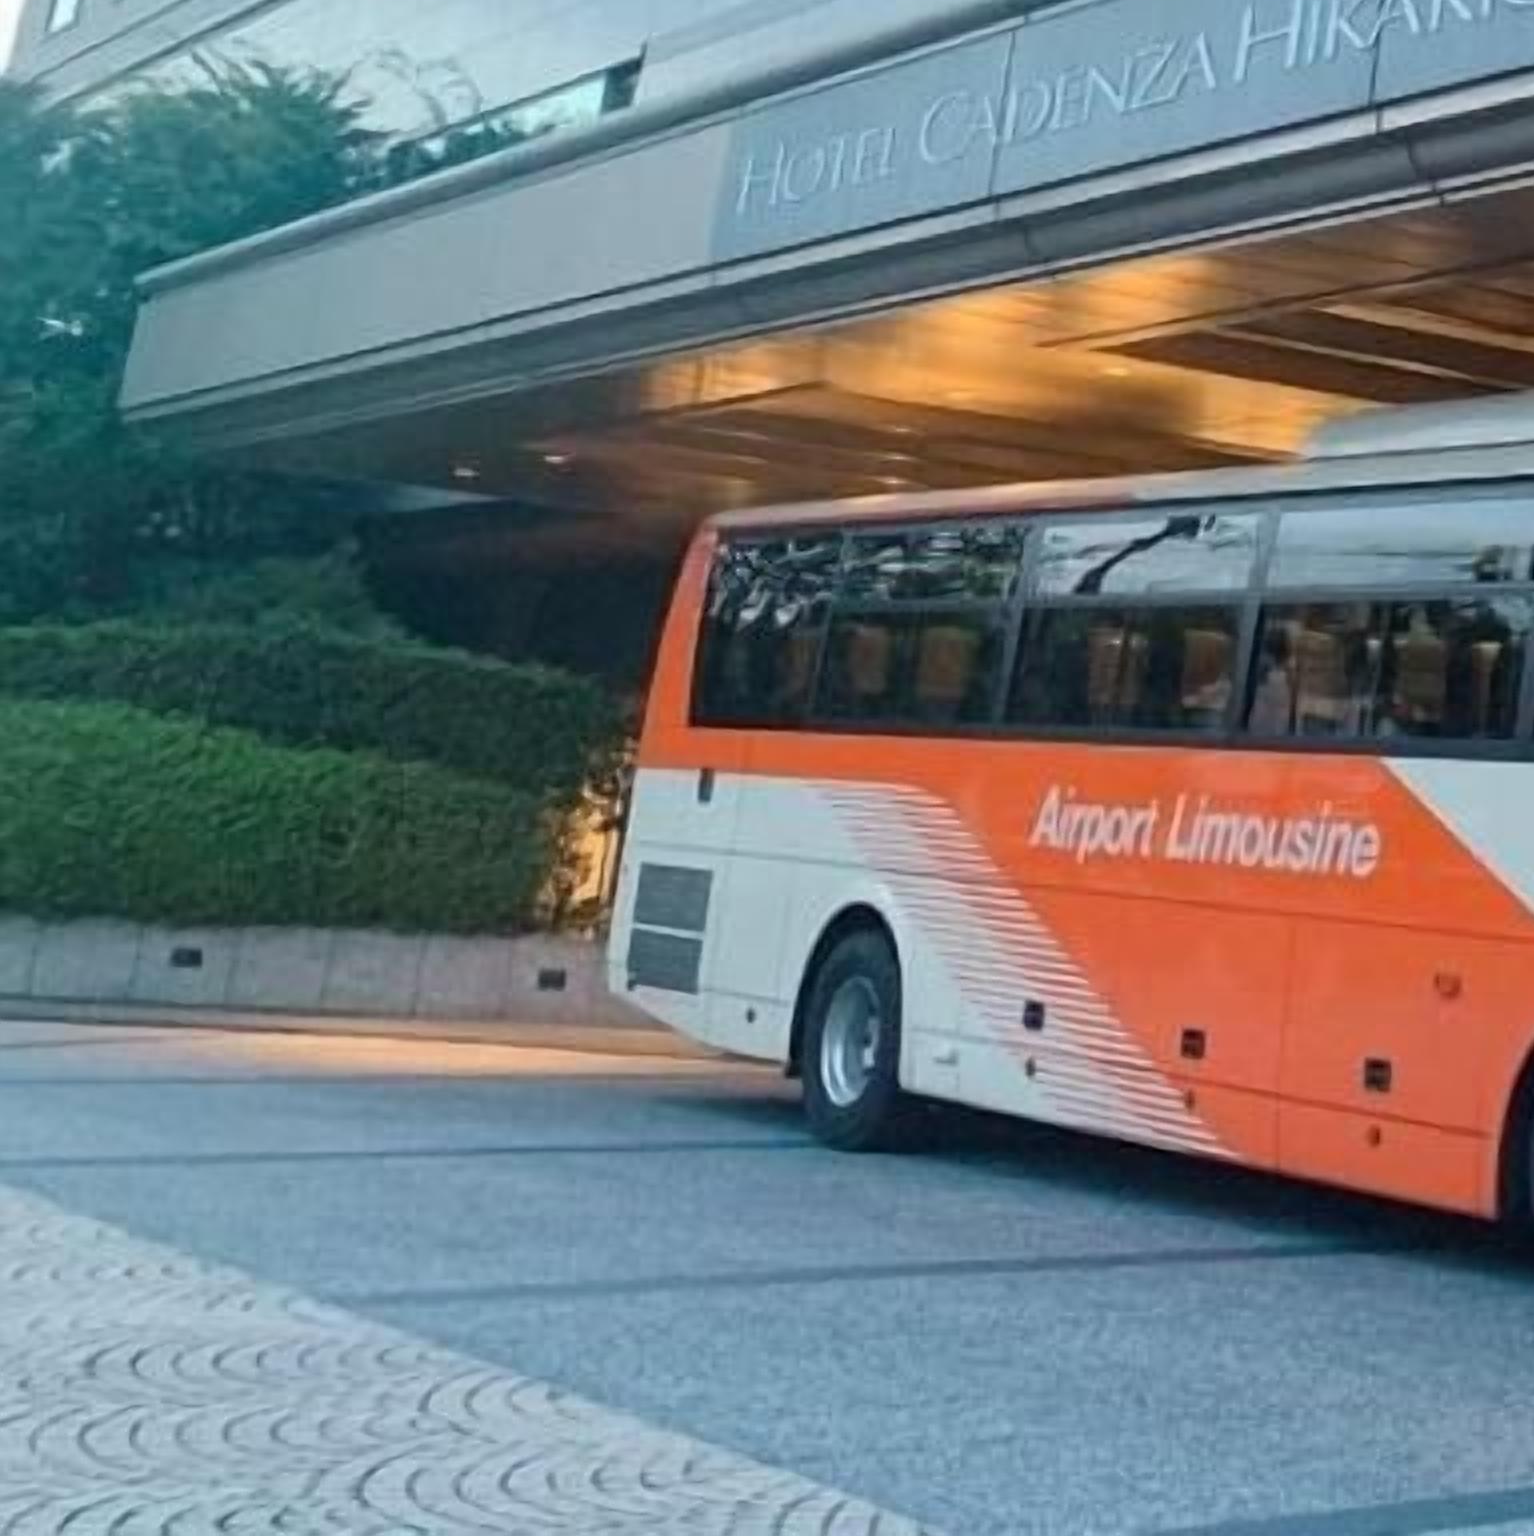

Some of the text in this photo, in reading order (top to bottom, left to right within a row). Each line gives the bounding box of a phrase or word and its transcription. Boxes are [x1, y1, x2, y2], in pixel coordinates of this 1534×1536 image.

[736, 126, 896, 214] HOTEL
[919, 31, 1216, 164] CADENZA
[1028, 784, 1382, 877] Airport Limousine
